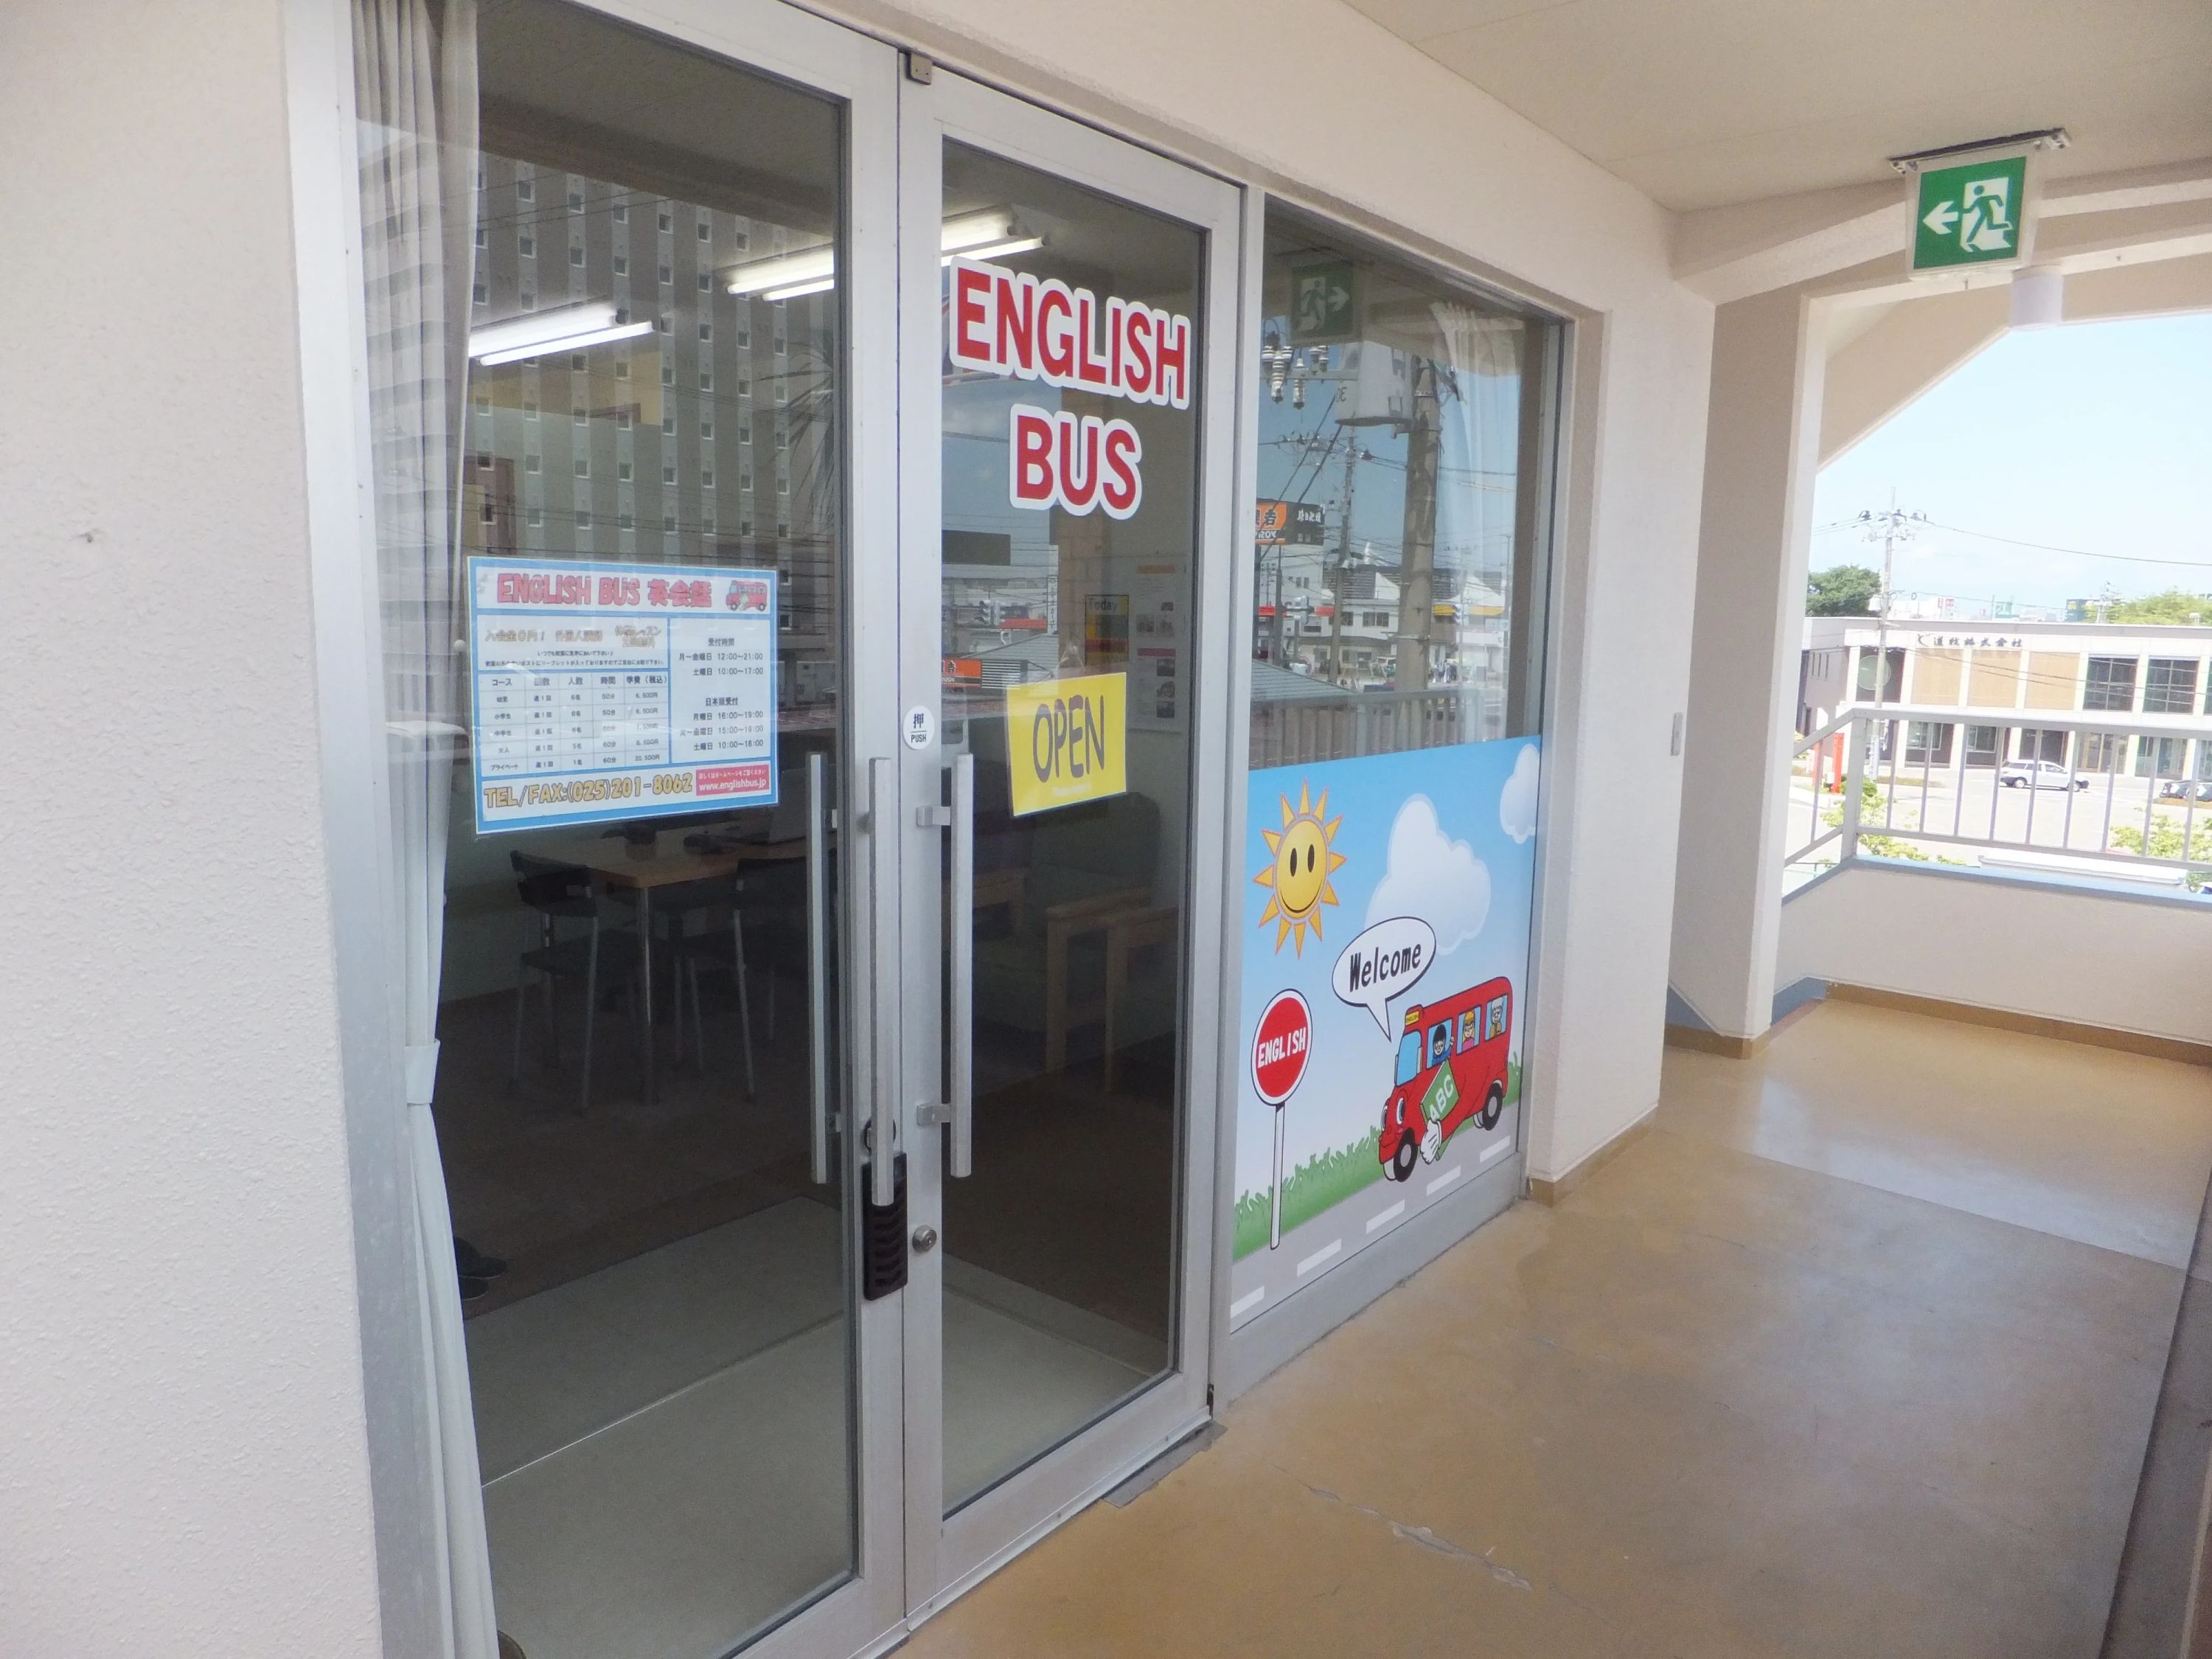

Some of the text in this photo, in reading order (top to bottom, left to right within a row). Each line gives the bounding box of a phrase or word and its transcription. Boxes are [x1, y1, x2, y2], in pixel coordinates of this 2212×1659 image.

[956, 265, 1187, 402] ENGLISH
[1016, 414, 1136, 511] BUS
[497, 574, 591, 605] ENGLISH
[598, 577, 641, 606] BUS
[568, 677, 583, 685] 人数
[692, 667, 713, 676] 土曜日
[913, 713, 925, 729] 押
[693, 742, 713, 751] 土曜日
[911, 734, 927, 743] PUSH
[1032, 695, 1105, 783] OPEN
[699, 778, 767, 791] www.englishbus.jp
[1349, 943, 1422, 992] Welcome
[1257, 1027, 1307, 1068] ENGLISH
[1429, 1074, 1453, 1121] ABC
